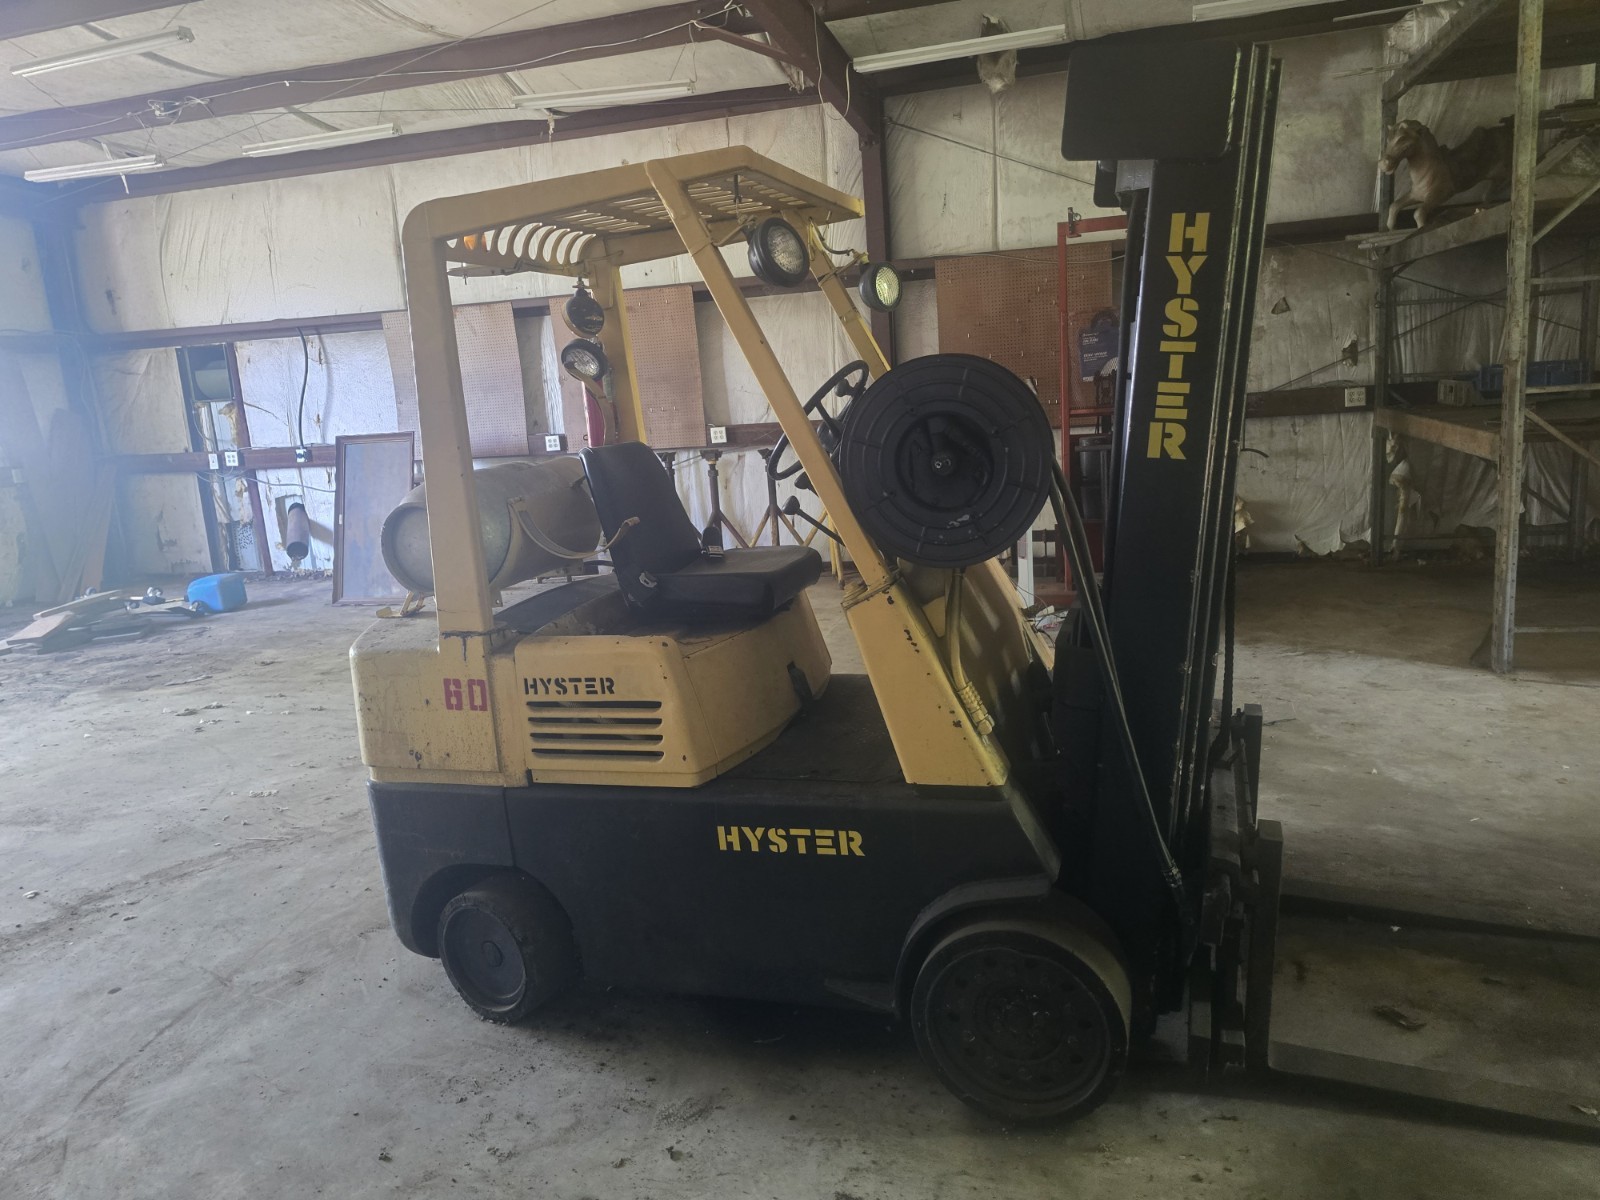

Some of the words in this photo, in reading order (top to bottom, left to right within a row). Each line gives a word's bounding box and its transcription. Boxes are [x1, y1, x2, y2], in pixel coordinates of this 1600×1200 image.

[1147, 212, 1210, 460] HYSTER
[443, 678, 488, 712] 60
[523, 677, 616, 696] HYSTER
[717, 825, 866, 857] HYSTER
